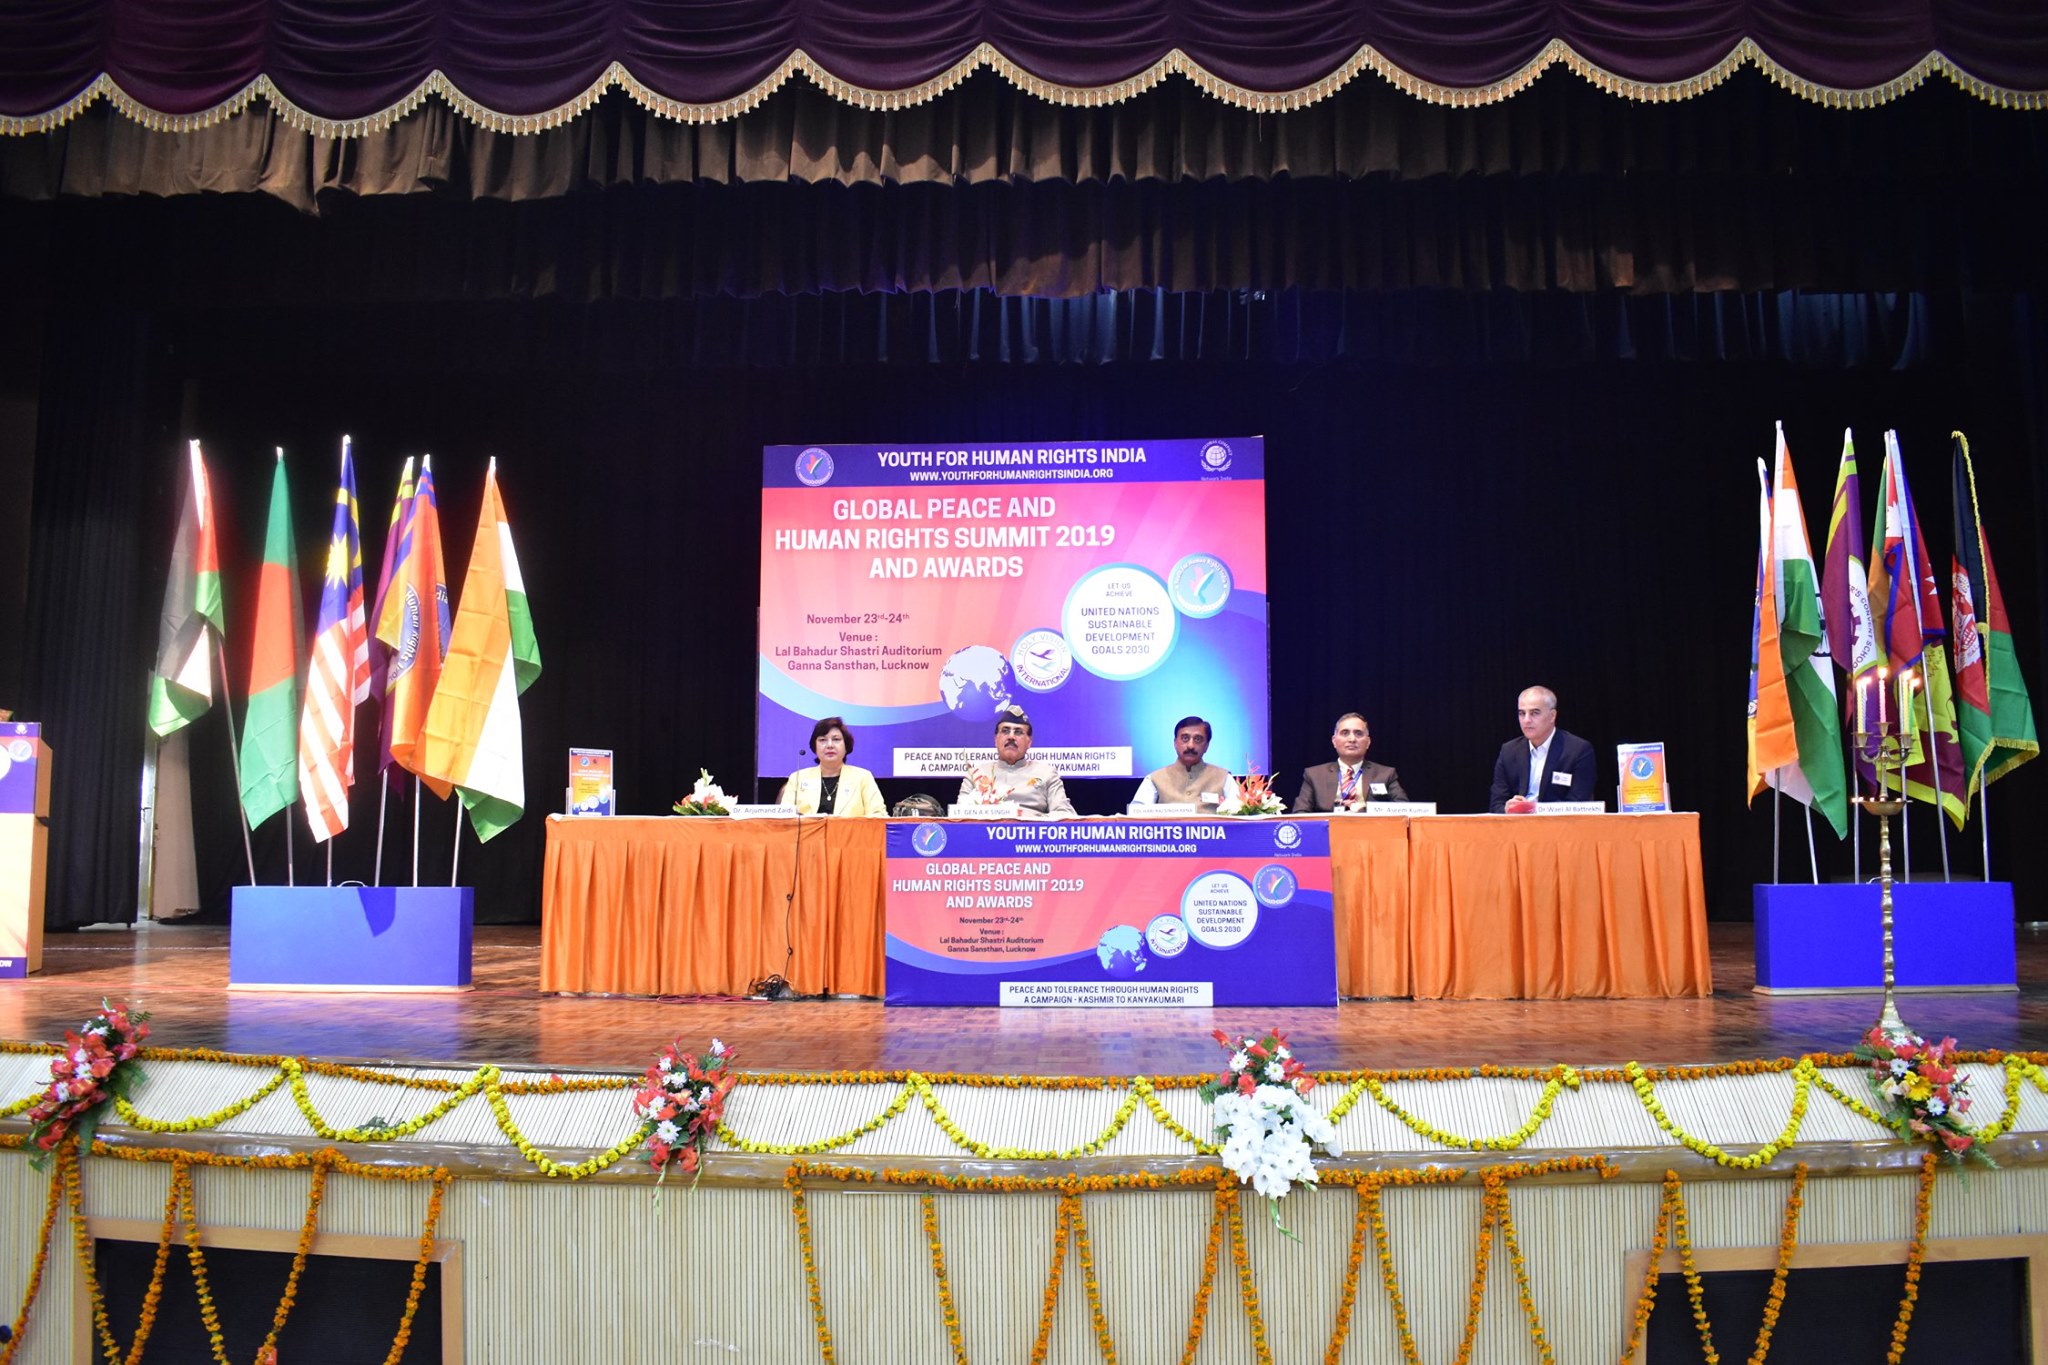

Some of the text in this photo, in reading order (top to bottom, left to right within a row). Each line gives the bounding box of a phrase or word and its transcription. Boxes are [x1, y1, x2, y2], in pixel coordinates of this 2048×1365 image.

[877, 447, 1146, 467] YOUTH FOR HUMAN RIGHTS INDIA
[910, 468, 1114, 481] WWW.YOUTHFORHUMANRIGHTSINDIA.ORG
[833, 497, 1056, 521] GLOBAL PEACE AND
[775, 524, 1115, 550] HUMAN RIGHTS SUMMIT 2019
[869, 556, 1023, 579] AND AWARDS
[405, 589, 420, 628] Human
[1081, 607, 1159, 616] UNITED NATIONS
[807, 614, 861, 624] November
[1861, 597, 1873, 639] CONVENT
[1088, 620, 1152, 629] SUSTAINABLE
[839, 632, 872, 642] Venue
[1086, 632, 1154, 642] DEVELOPMENT
[775, 645, 942, 656] Lal Bahadur Shastri Auditorium
[1092, 645, 1150, 654] GOALS 2030
[1852, 640, 1873, 669] SCHOO
[788, 659, 929, 671] Ganna Sansthan, Lucknow
[1017, 664, 1069, 687] INTERNATIONAL
[904, 752, 1116, 761] PEACE AND TOLERANC OUGH HUMAN RIGHTS
[921, 763, 927, 772] A
[986, 826, 1226, 840] YOUTH FOR HUMAN RIGHTS INDIA
[1015, 844, 1197, 853] WWW.YOUTHFORHUMANRIGHTSINDIA.ORG
[926, 863, 1051, 875] GLOBAL PEACE AND
[892, 879, 1084, 892] HUMAN RIGHTS SUMMIT 2019
[946, 896, 1033, 908] AND AWARDS
